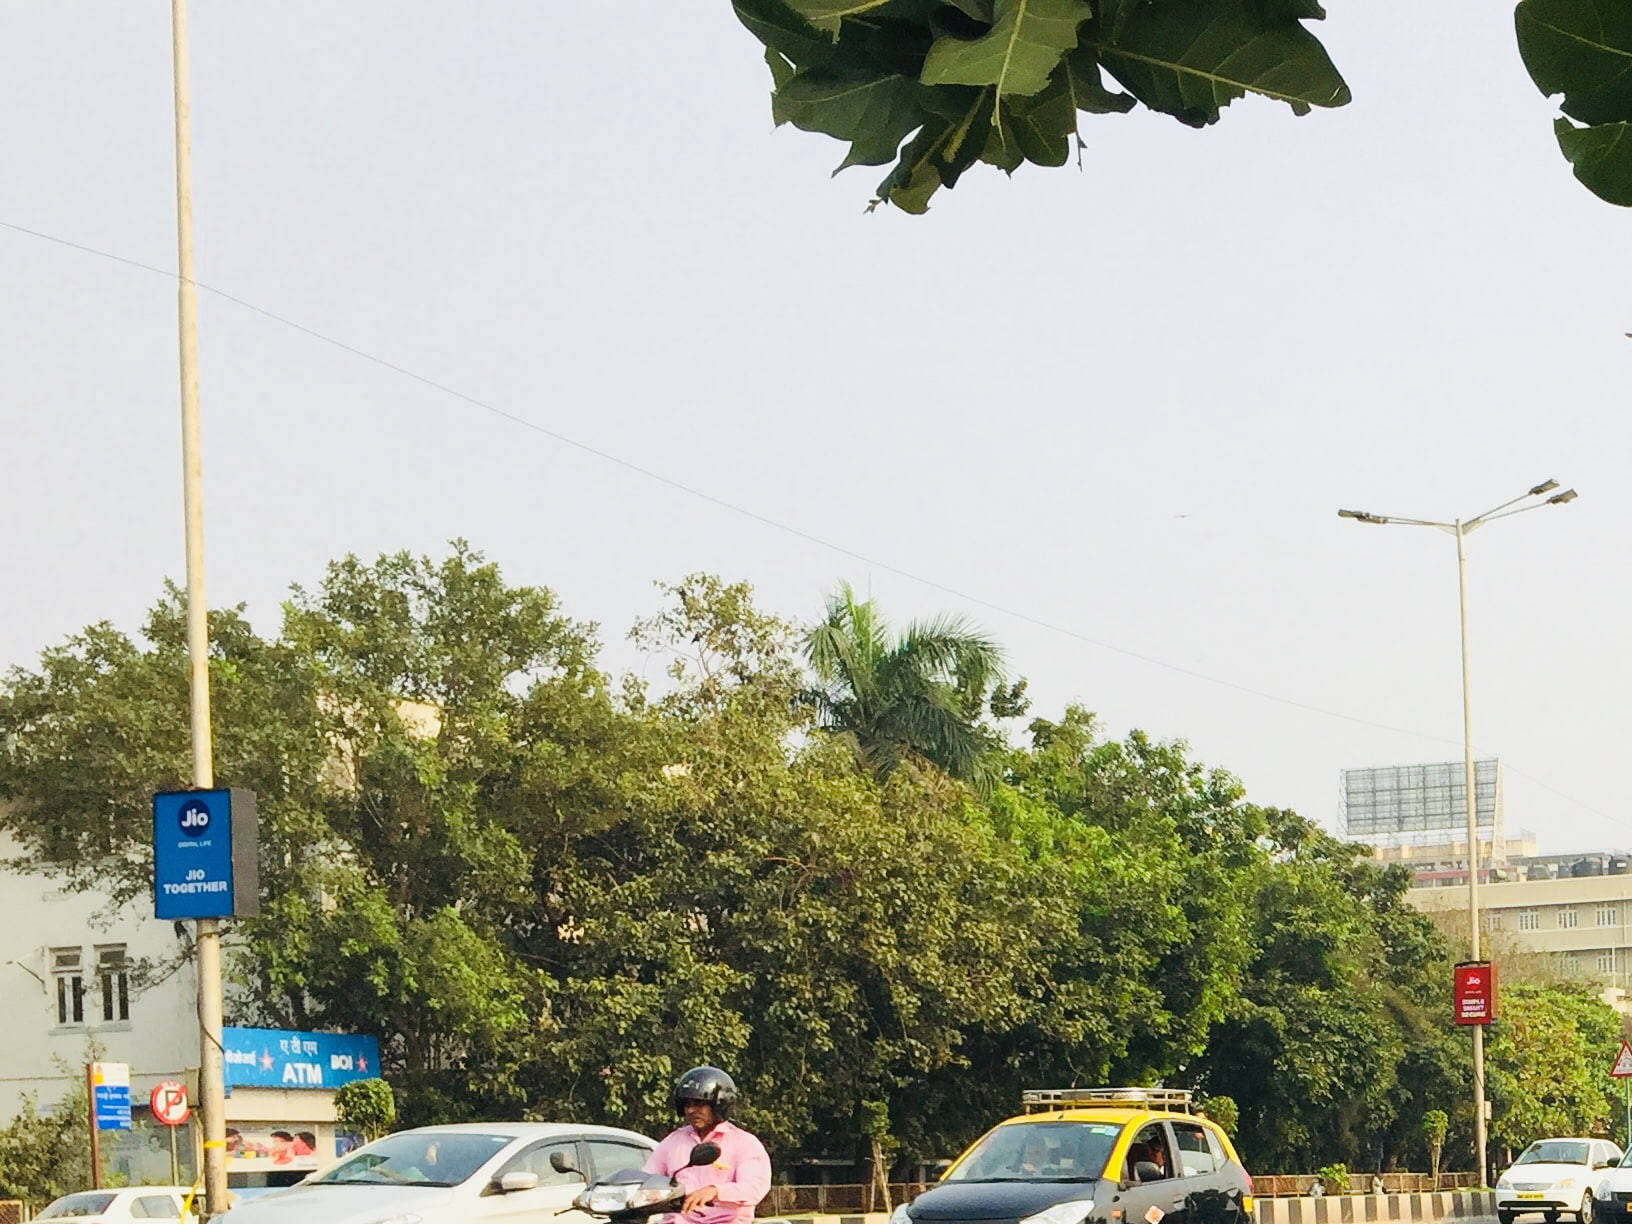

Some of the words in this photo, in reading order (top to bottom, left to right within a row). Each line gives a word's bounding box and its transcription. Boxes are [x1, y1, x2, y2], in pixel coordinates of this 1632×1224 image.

[181, 808, 209, 827] Jio
[185, 869, 206, 881] JIO
[163, 881, 228, 895] TOGETHER
[282, 1062, 323, 1084] ATM
